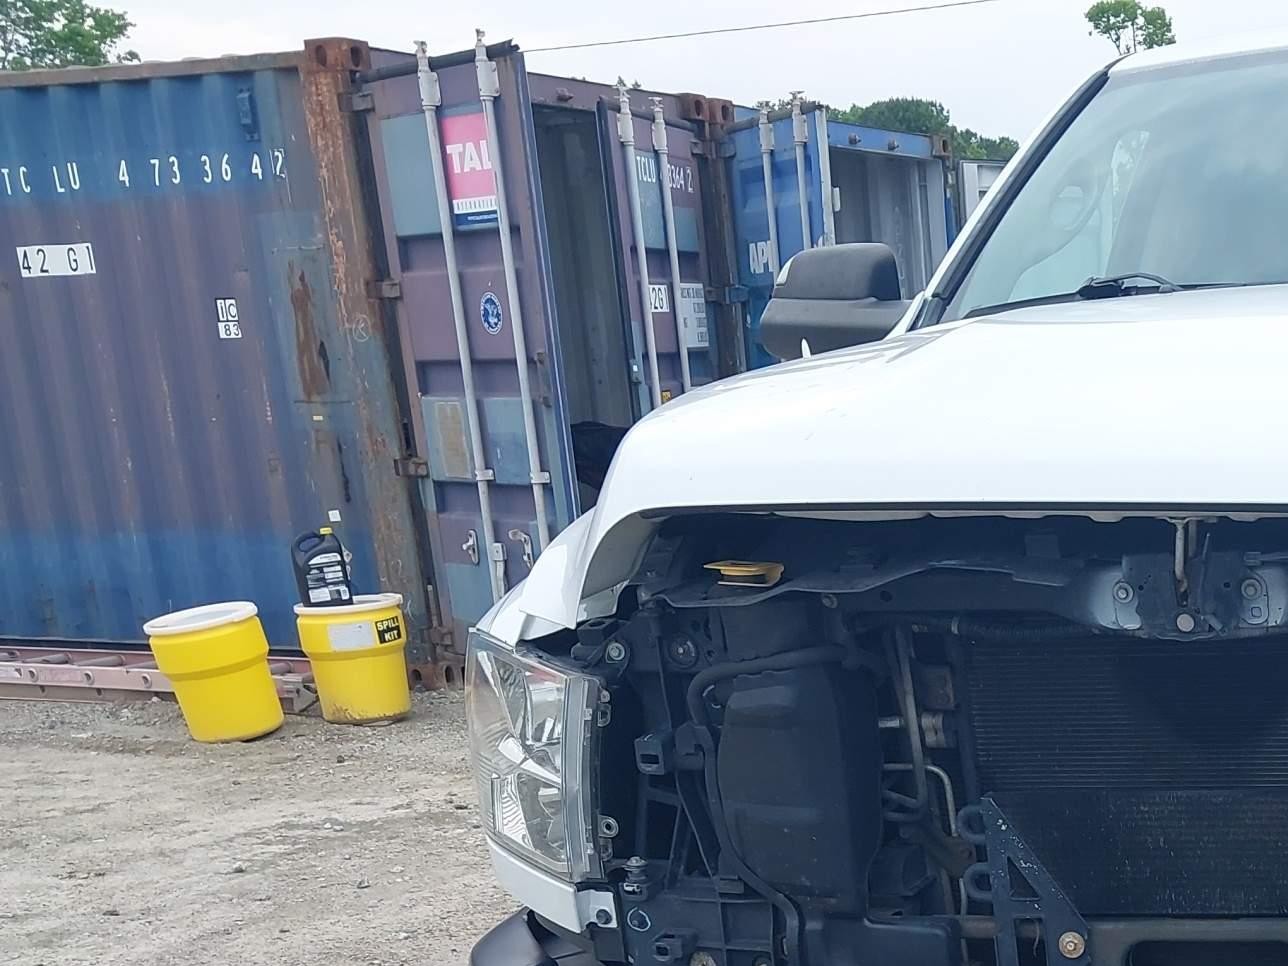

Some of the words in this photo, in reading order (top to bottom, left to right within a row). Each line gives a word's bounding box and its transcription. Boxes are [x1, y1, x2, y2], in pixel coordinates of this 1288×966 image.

[446, 140, 492, 174] TAL
[636, 155, 656, 183] TCLU
[224, 323, 240, 337] 83
[376, 617, 399, 631] SPILL
[384, 630, 399, 642] KIT
